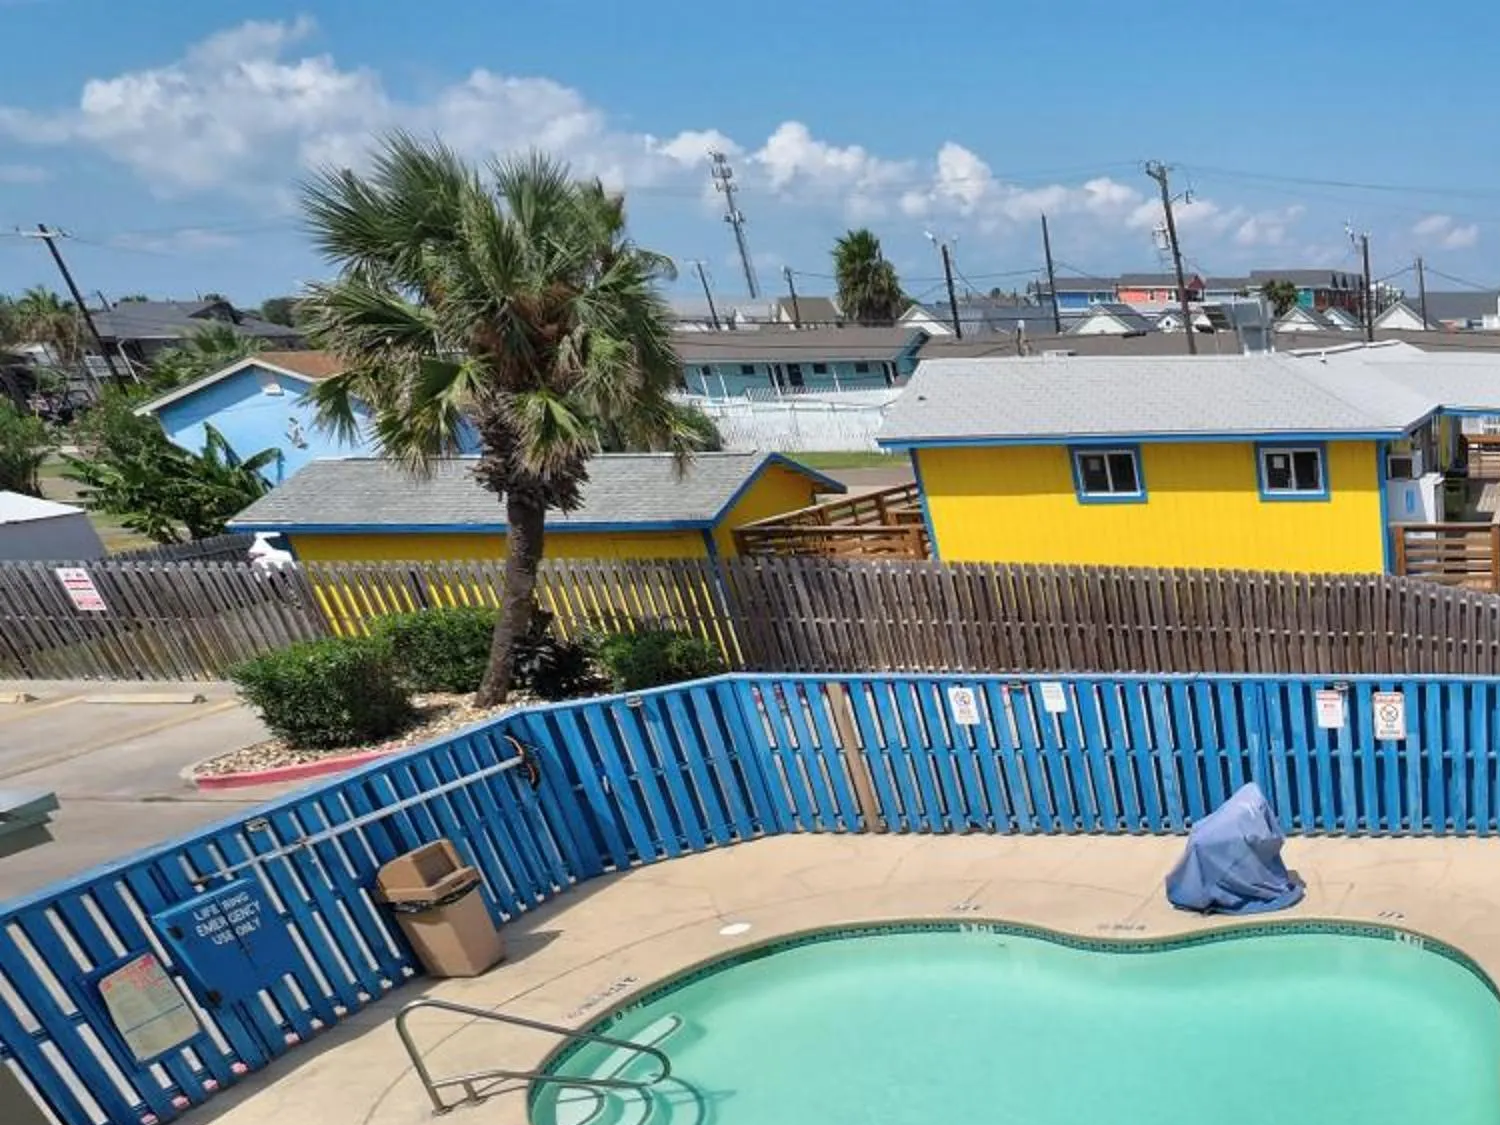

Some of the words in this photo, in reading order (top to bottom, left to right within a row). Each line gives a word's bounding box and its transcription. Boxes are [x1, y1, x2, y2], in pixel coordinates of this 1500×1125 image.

[193, 904, 221, 920] LIFE
[211, 929, 236, 945] USE
[235, 916, 261, 937] ONLY
